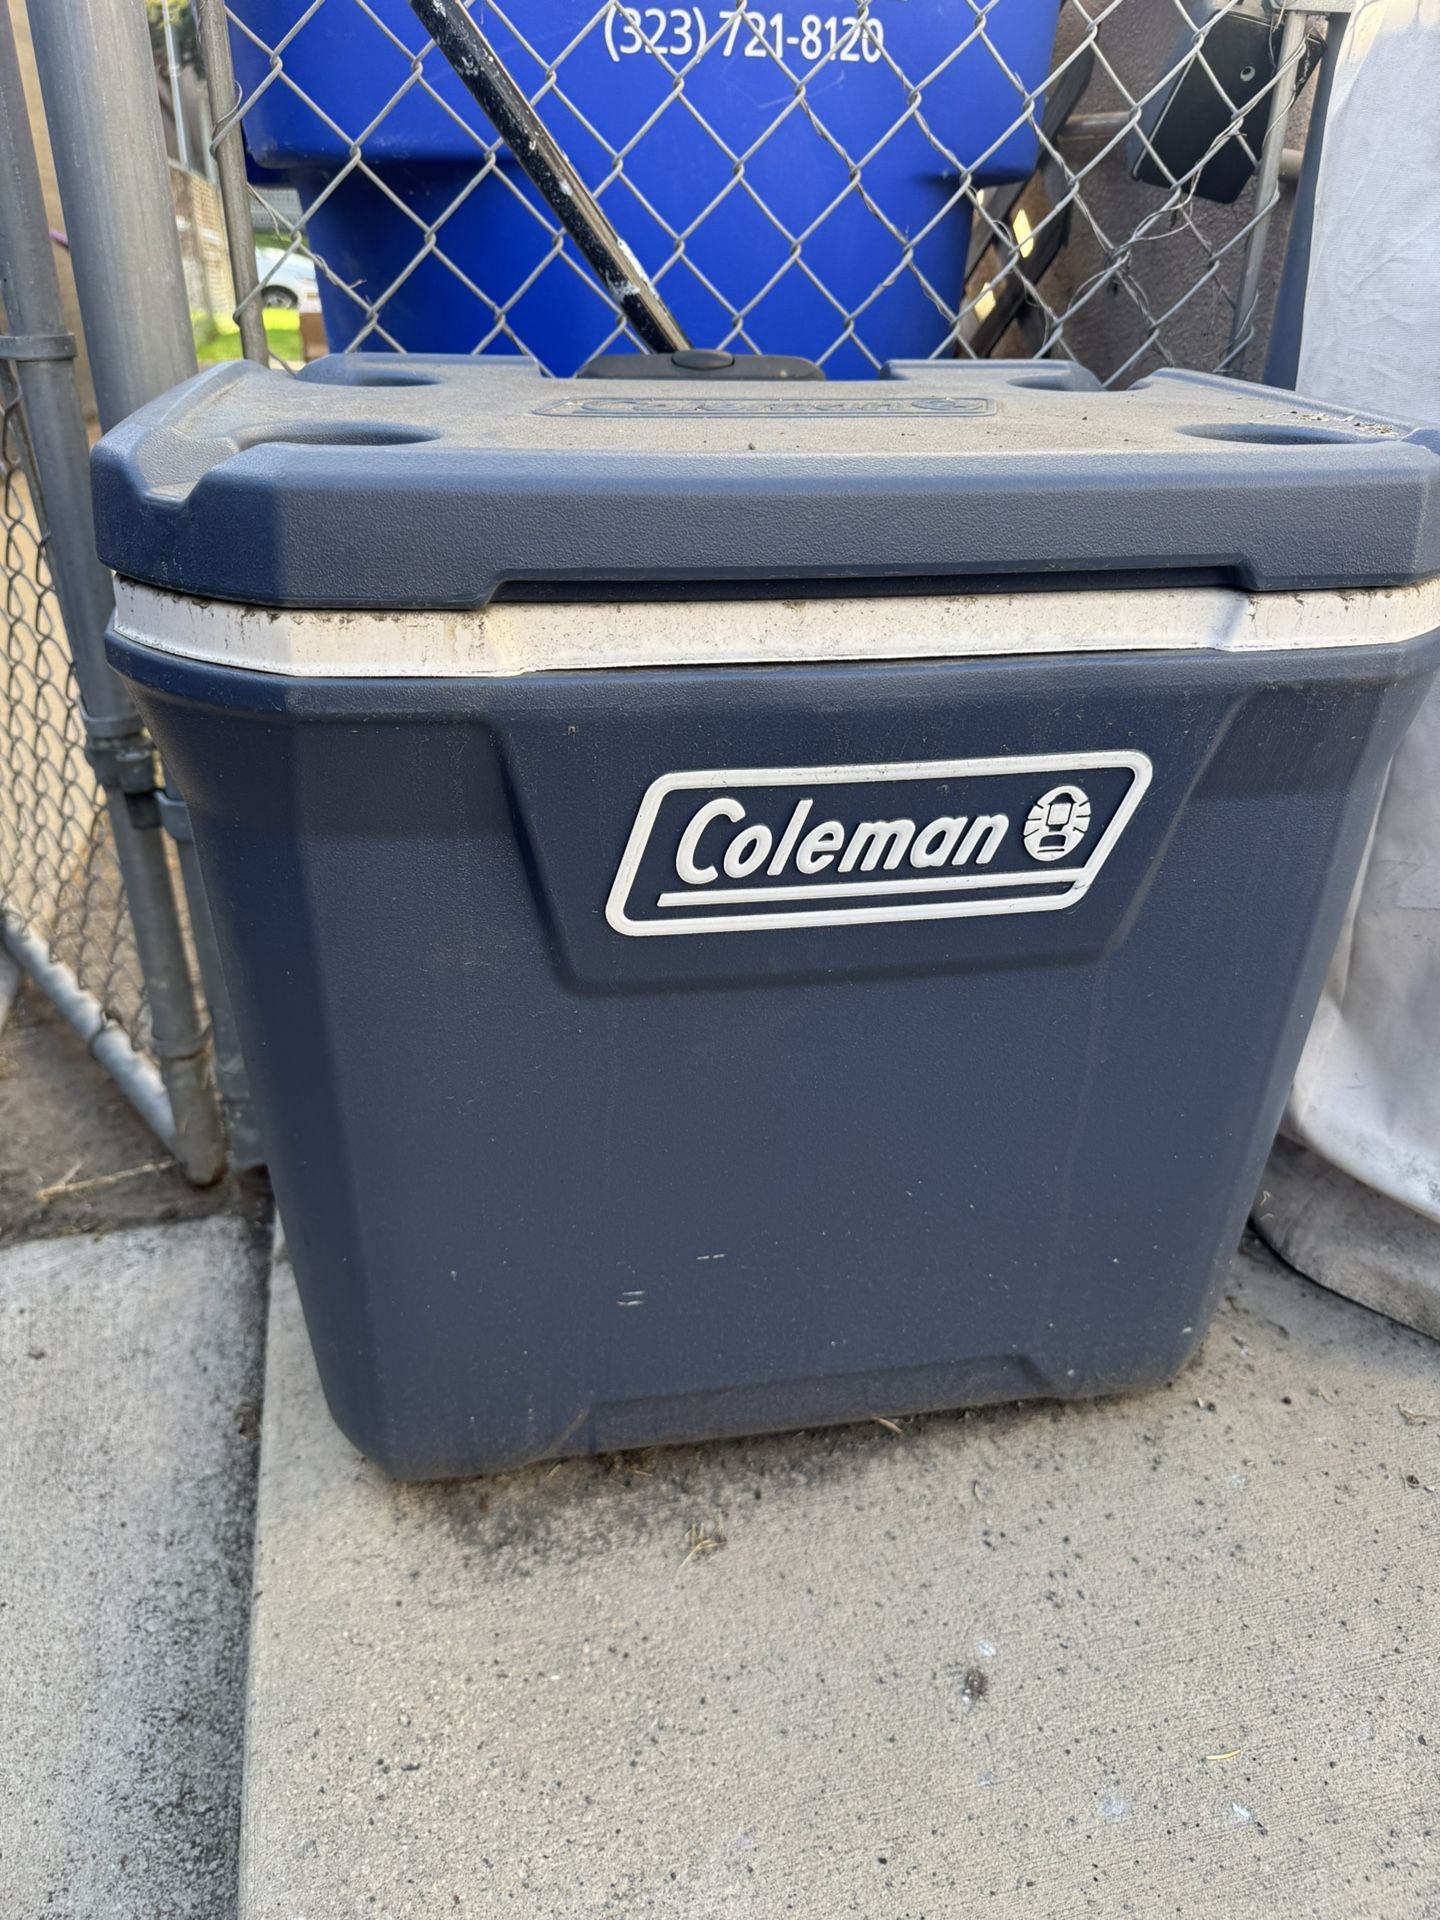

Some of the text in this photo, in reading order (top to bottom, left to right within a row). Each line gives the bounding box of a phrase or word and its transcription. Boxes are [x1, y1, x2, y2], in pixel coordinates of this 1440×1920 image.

[604, 4, 884, 63] (323) 721-8120
[675, 797, 1009, 885] Coleman
